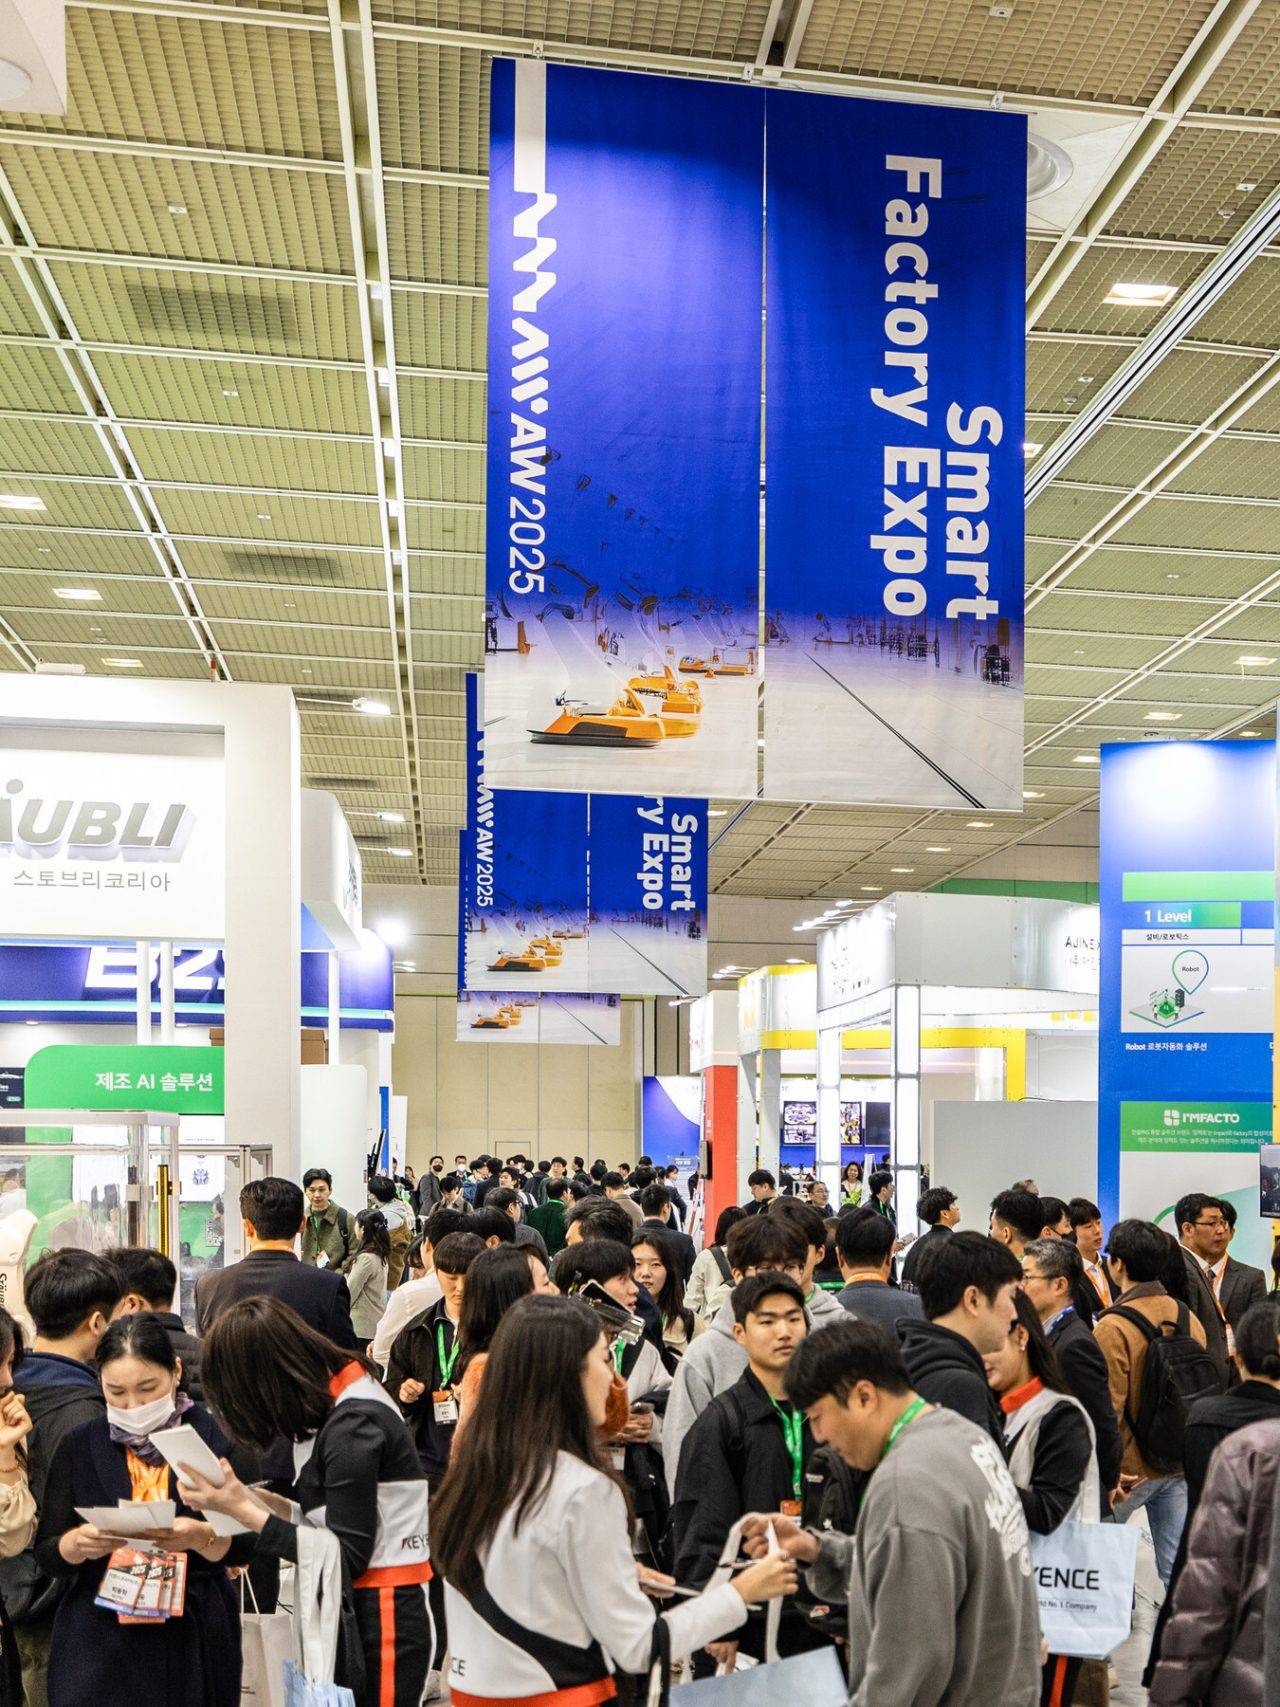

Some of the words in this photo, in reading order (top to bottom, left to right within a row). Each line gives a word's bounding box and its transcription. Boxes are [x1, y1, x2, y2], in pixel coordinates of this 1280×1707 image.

[870, 153, 943, 427] Factory
[870, 445, 942, 617] Expo
[945, 401, 1004, 621] Smart
[13, 869, 171, 892] 스토브리코리아
[637, 832, 670, 911] Expo
[670, 812, 698, 911] Smart
[1144, 910, 1151, 923] 1
[1157, 909, 1192, 923] Level
[1181, 965, 1200, 973] Robot
[1125, 1042, 1146, 1051] Robot
[95, 1071, 131, 1092] 제조
[136, 1073, 155, 1090] AI
[159, 1071, 213, 1092] 솔루션
